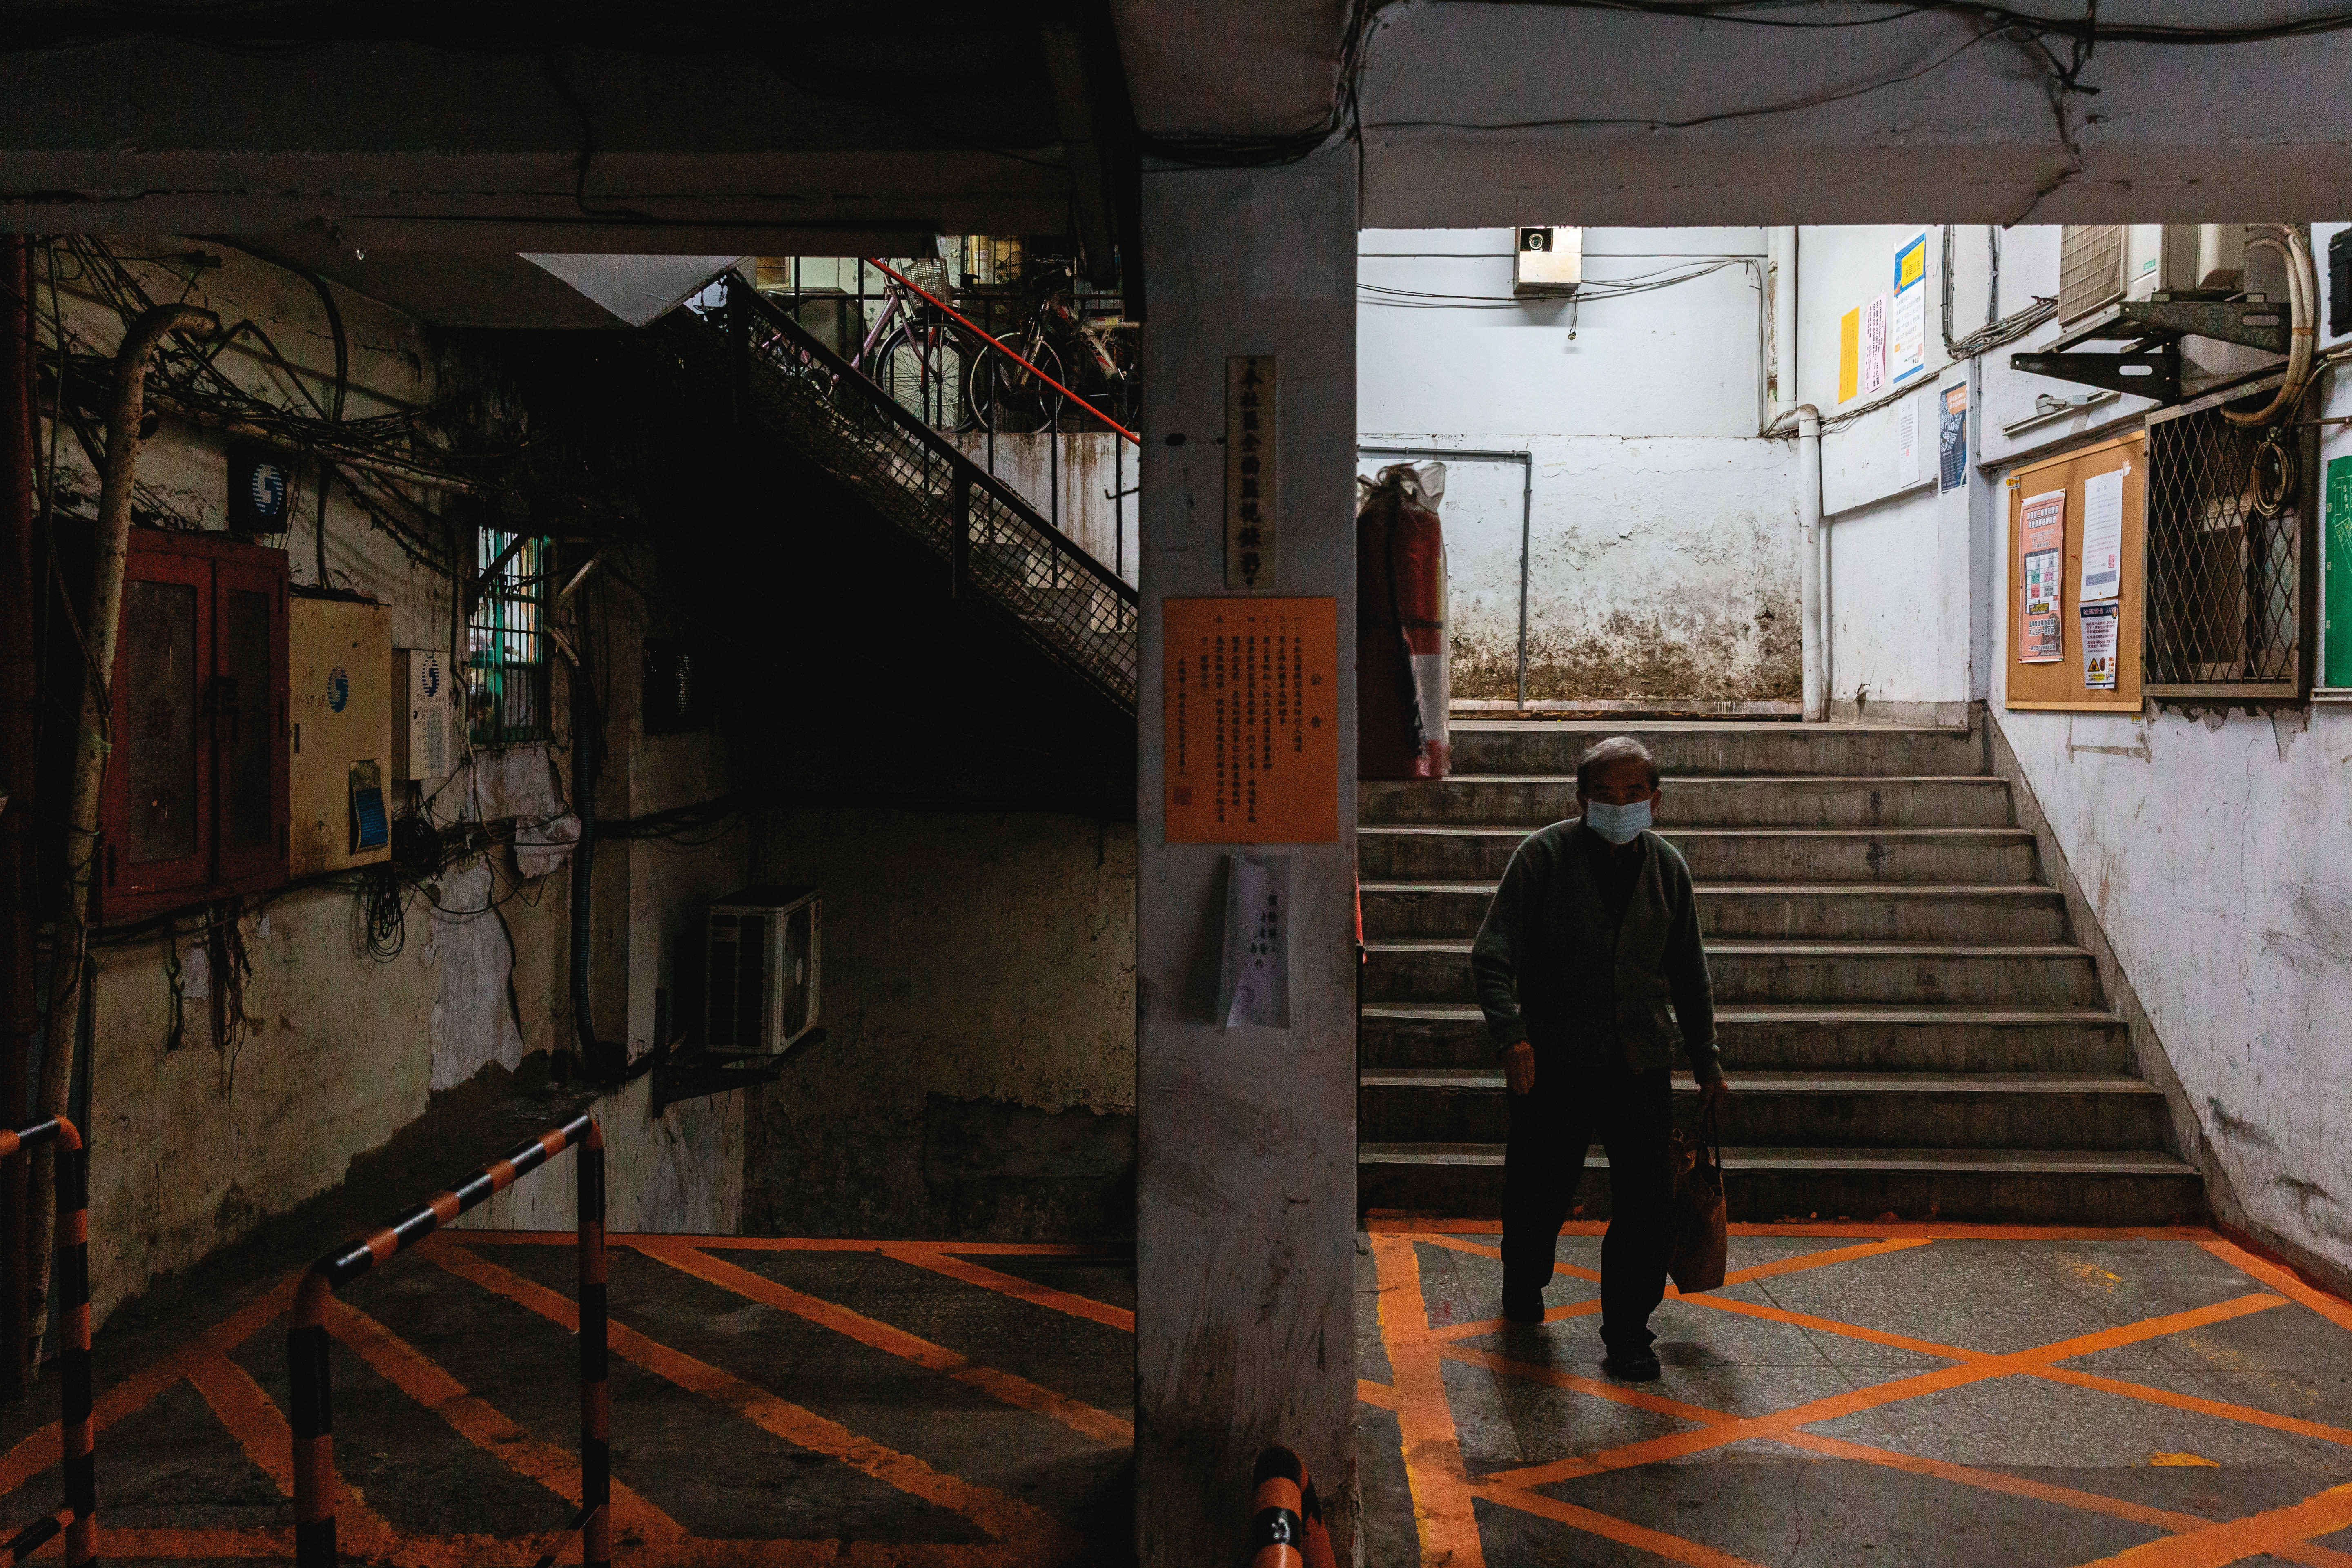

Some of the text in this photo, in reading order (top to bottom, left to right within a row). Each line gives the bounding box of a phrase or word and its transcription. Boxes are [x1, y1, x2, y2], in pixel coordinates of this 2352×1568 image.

[1238, 368, 1265, 576] 本社區全面監視錄影
